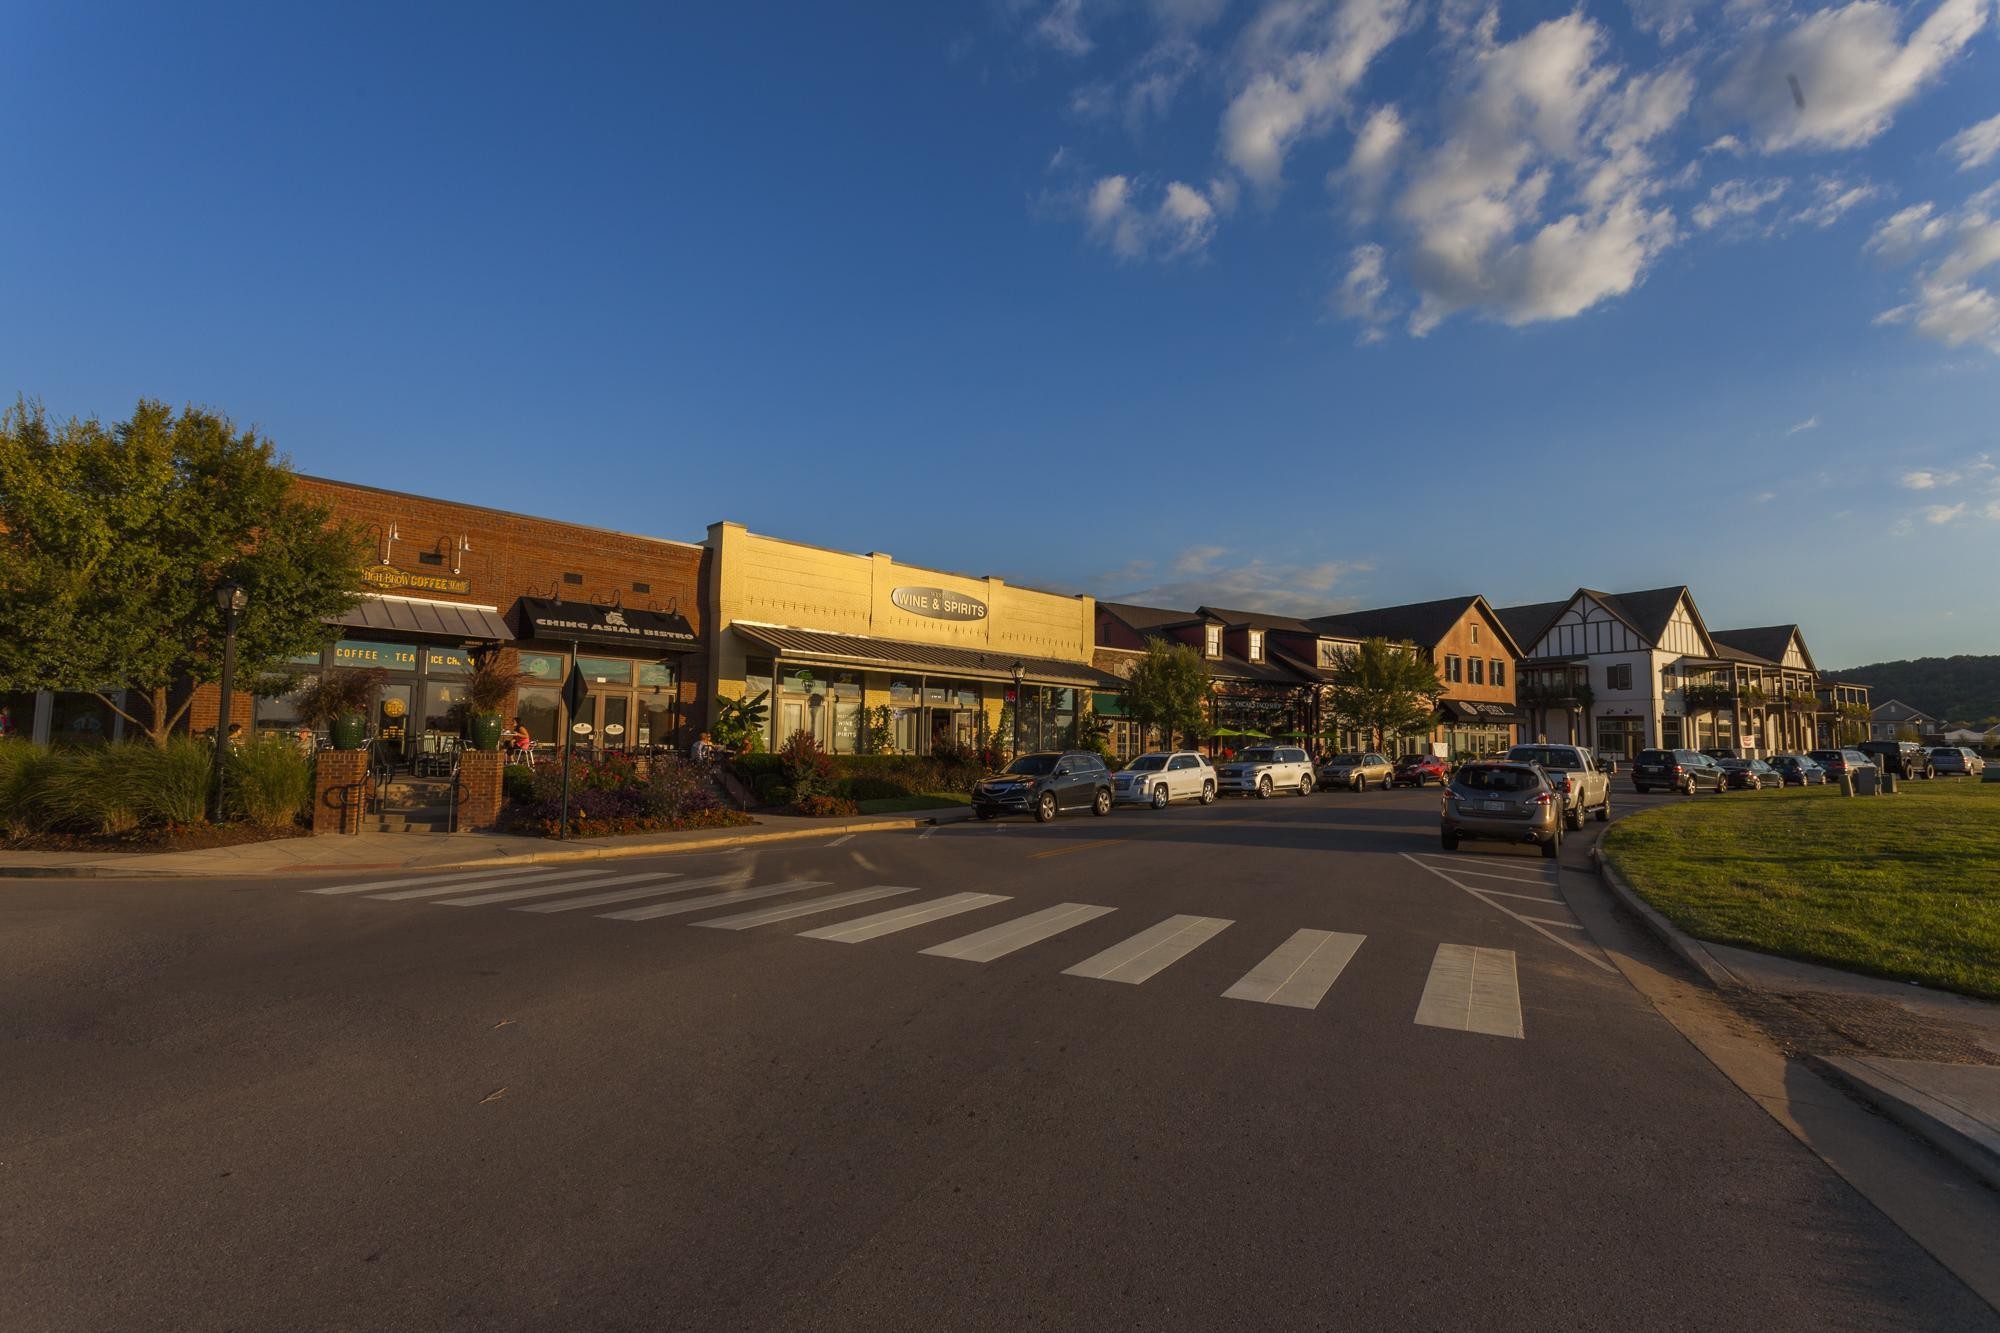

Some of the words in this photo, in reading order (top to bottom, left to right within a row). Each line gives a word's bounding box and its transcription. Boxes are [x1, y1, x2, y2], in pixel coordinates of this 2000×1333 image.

[411, 575, 448, 590] COFFEE
[898, 591, 928, 608] WINE
[932, 598, 940, 610] &
[944, 600, 985, 617] SPIRITS
[536, 618, 588, 630] CHING
[591, 624, 640, 635] ASIAN
[644, 629, 694, 640] BISTRO
[336, 648, 378, 660] COFFEE
[396, 652, 415, 663] TEA
[430, 655, 443, 664] ICE
